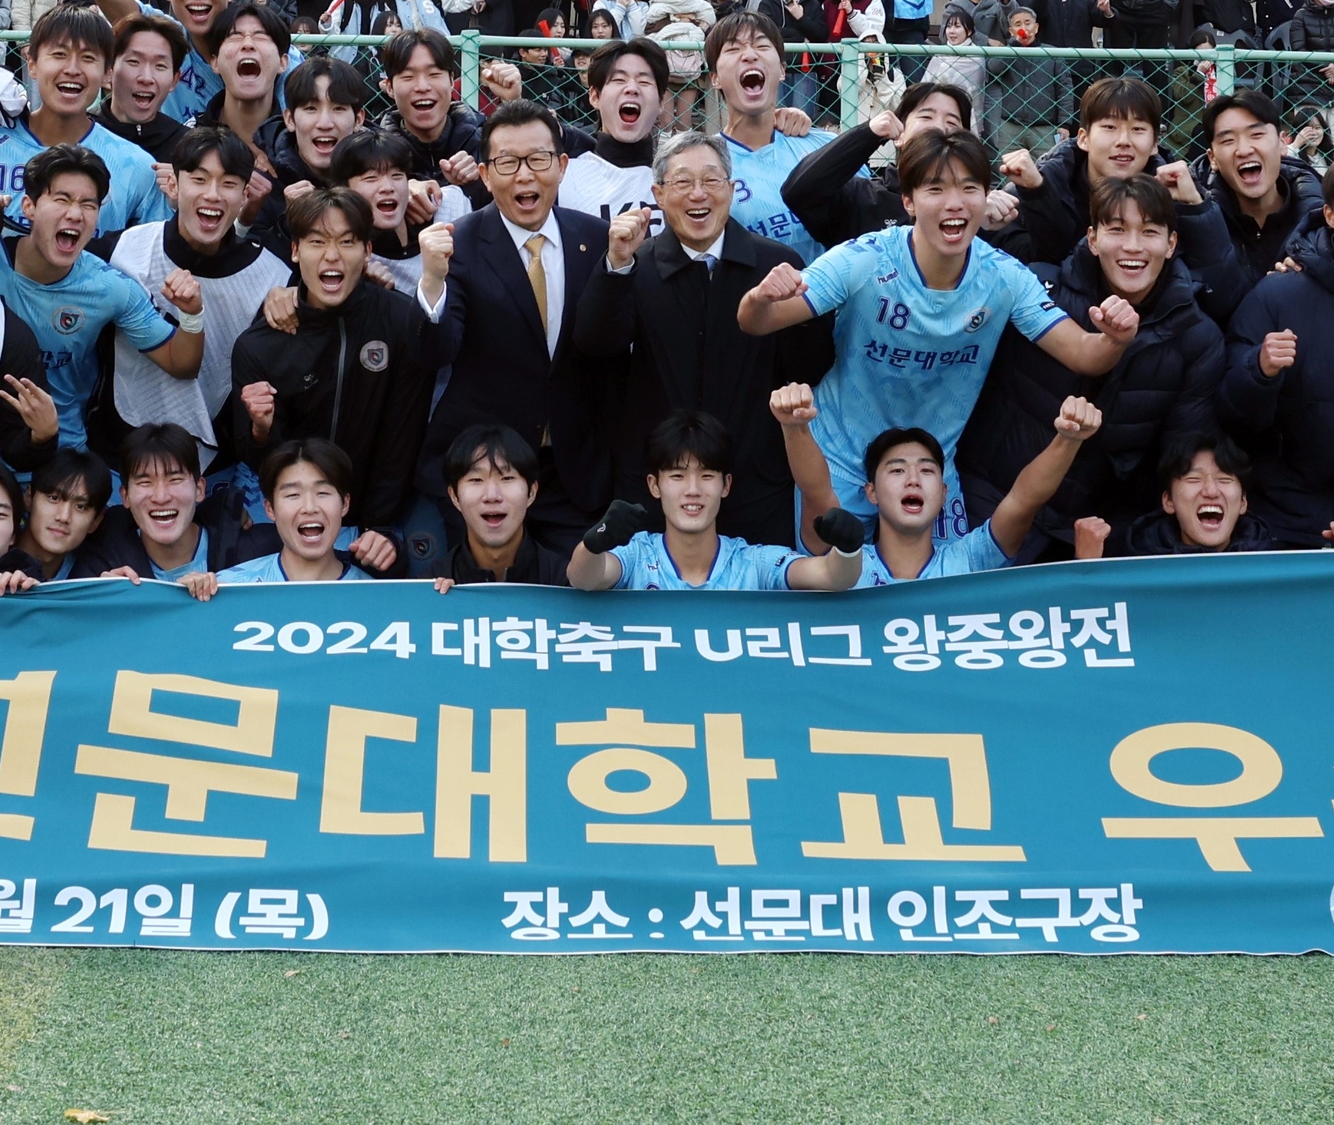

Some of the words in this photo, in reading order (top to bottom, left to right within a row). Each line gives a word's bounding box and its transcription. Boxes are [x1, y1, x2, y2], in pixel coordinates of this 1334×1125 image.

[179, 65, 207, 98] 42
[875, 295, 912, 332] 18
[863, 338, 981, 371] 선문대학교
[232, 621, 416, 659] 2024
[431, 616, 681, 672] 대학축구
[694, 621, 872, 668] U리그
[882, 602, 1135, 672] 왕중왕전
[51, 883, 195, 938] 21일
[214, 888, 329, 940] (목)
[502, 887, 634, 941] 장소
[680, 887, 874, 942] 선문대
[887, 884, 1143, 943] 인조구장
